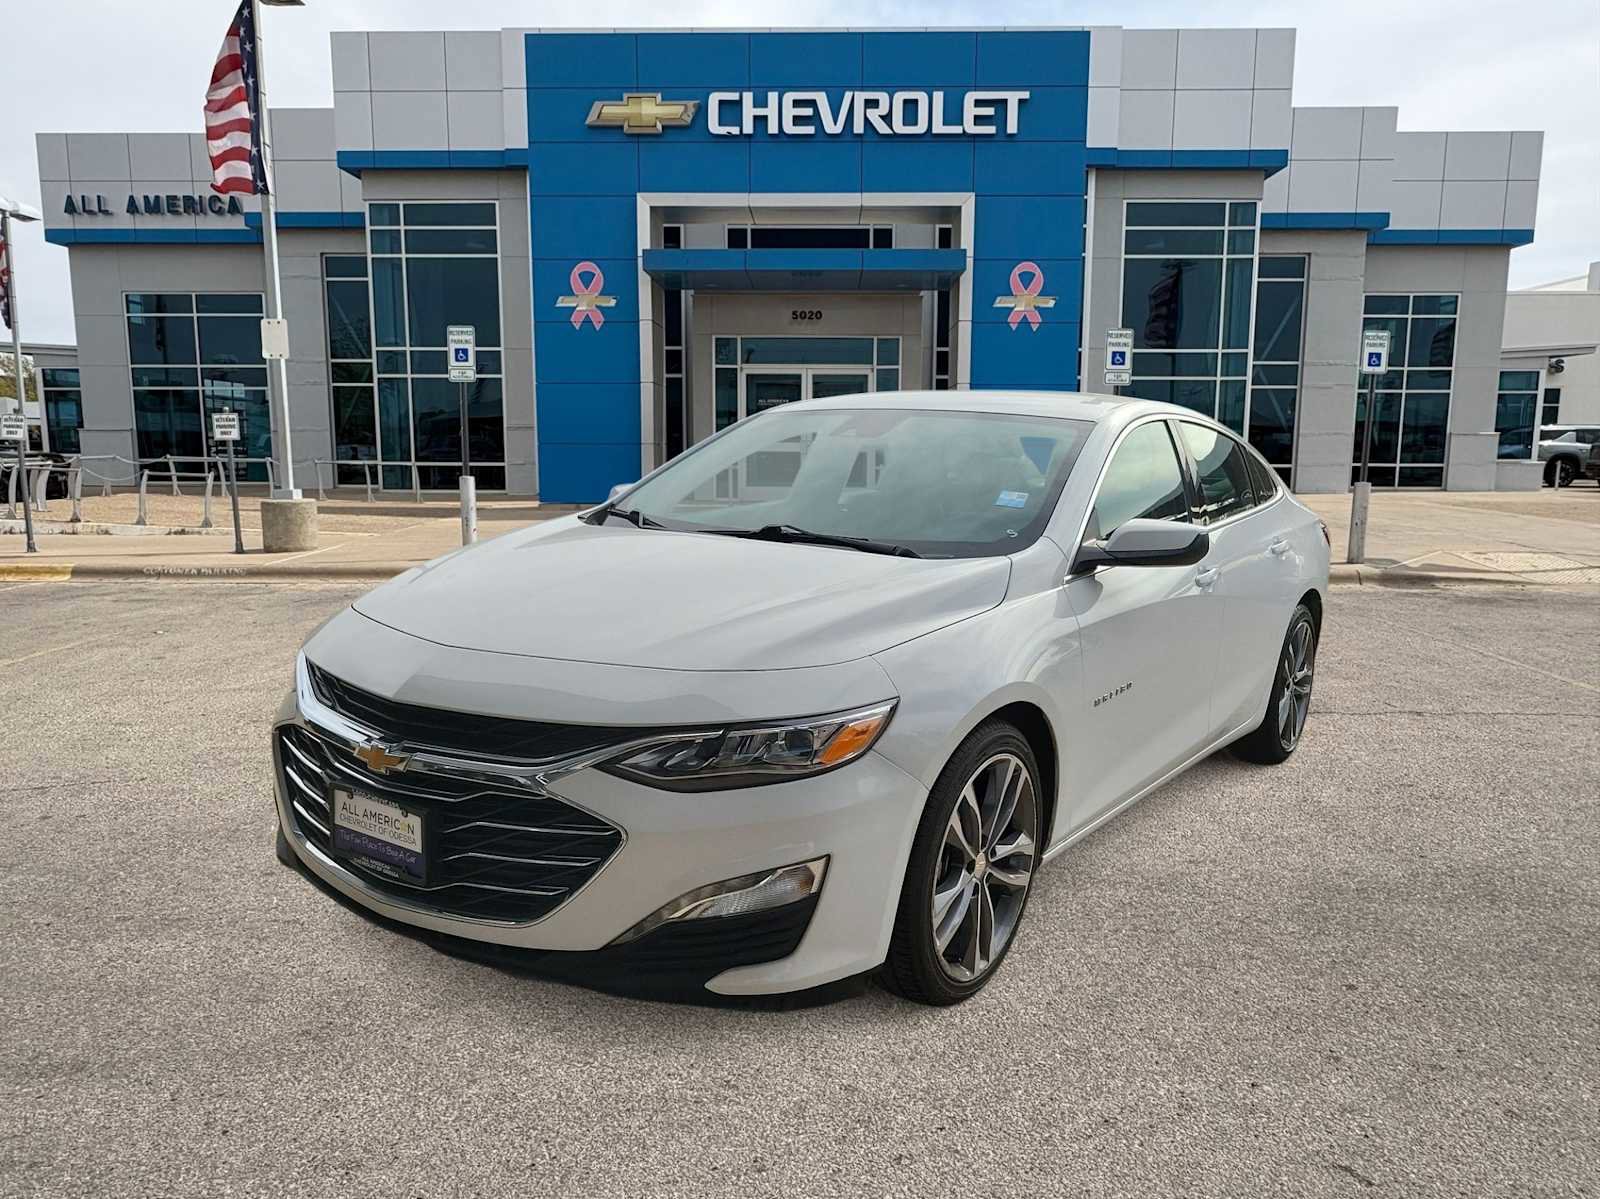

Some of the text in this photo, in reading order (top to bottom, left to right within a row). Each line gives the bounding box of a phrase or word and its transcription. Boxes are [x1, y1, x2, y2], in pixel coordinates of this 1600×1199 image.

[708, 91, 1030, 135] CHEVROLET
[64, 195, 244, 216] ALL AMERICA
[791, 310, 823, 320] 5020
[341, 801, 360, 817] ALL
